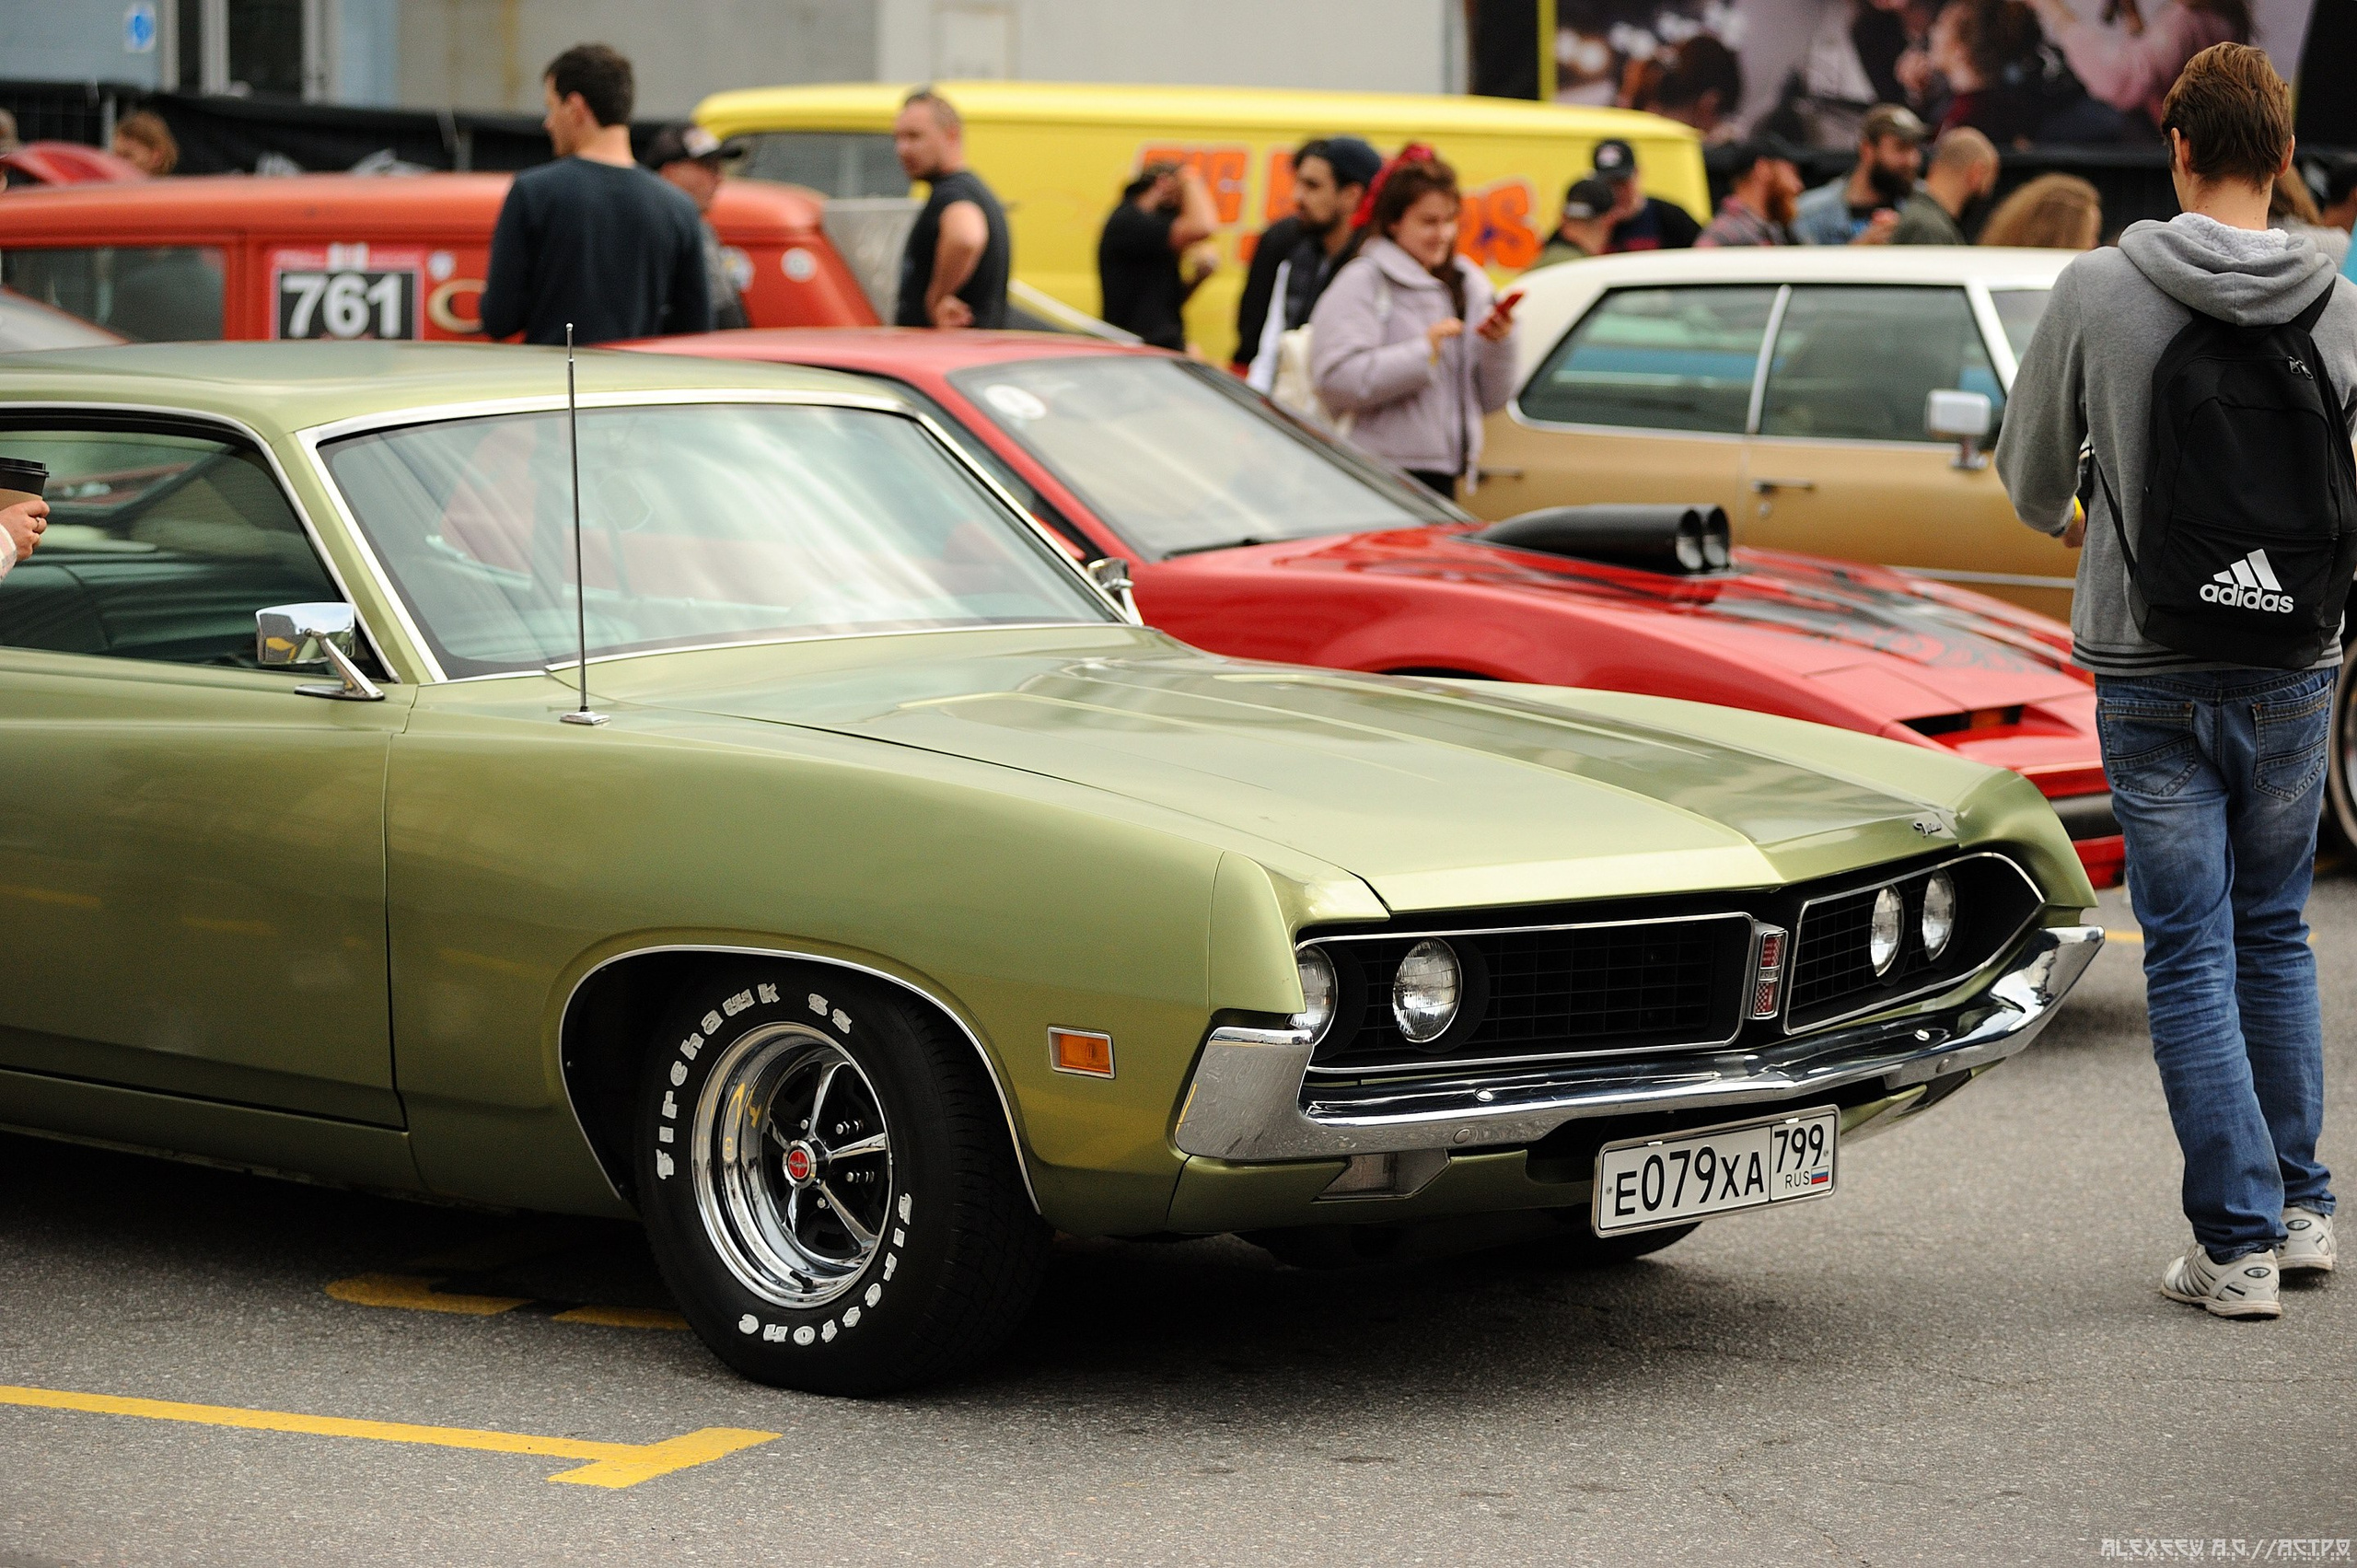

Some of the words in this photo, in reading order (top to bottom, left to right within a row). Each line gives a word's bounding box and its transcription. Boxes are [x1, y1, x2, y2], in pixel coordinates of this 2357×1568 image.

[280, 271, 403, 339] 761
[2199, 583, 2294, 614] adidas
[1773, 1123, 1825, 1174] 799
[1784, 1169, 1811, 1190] RUS
